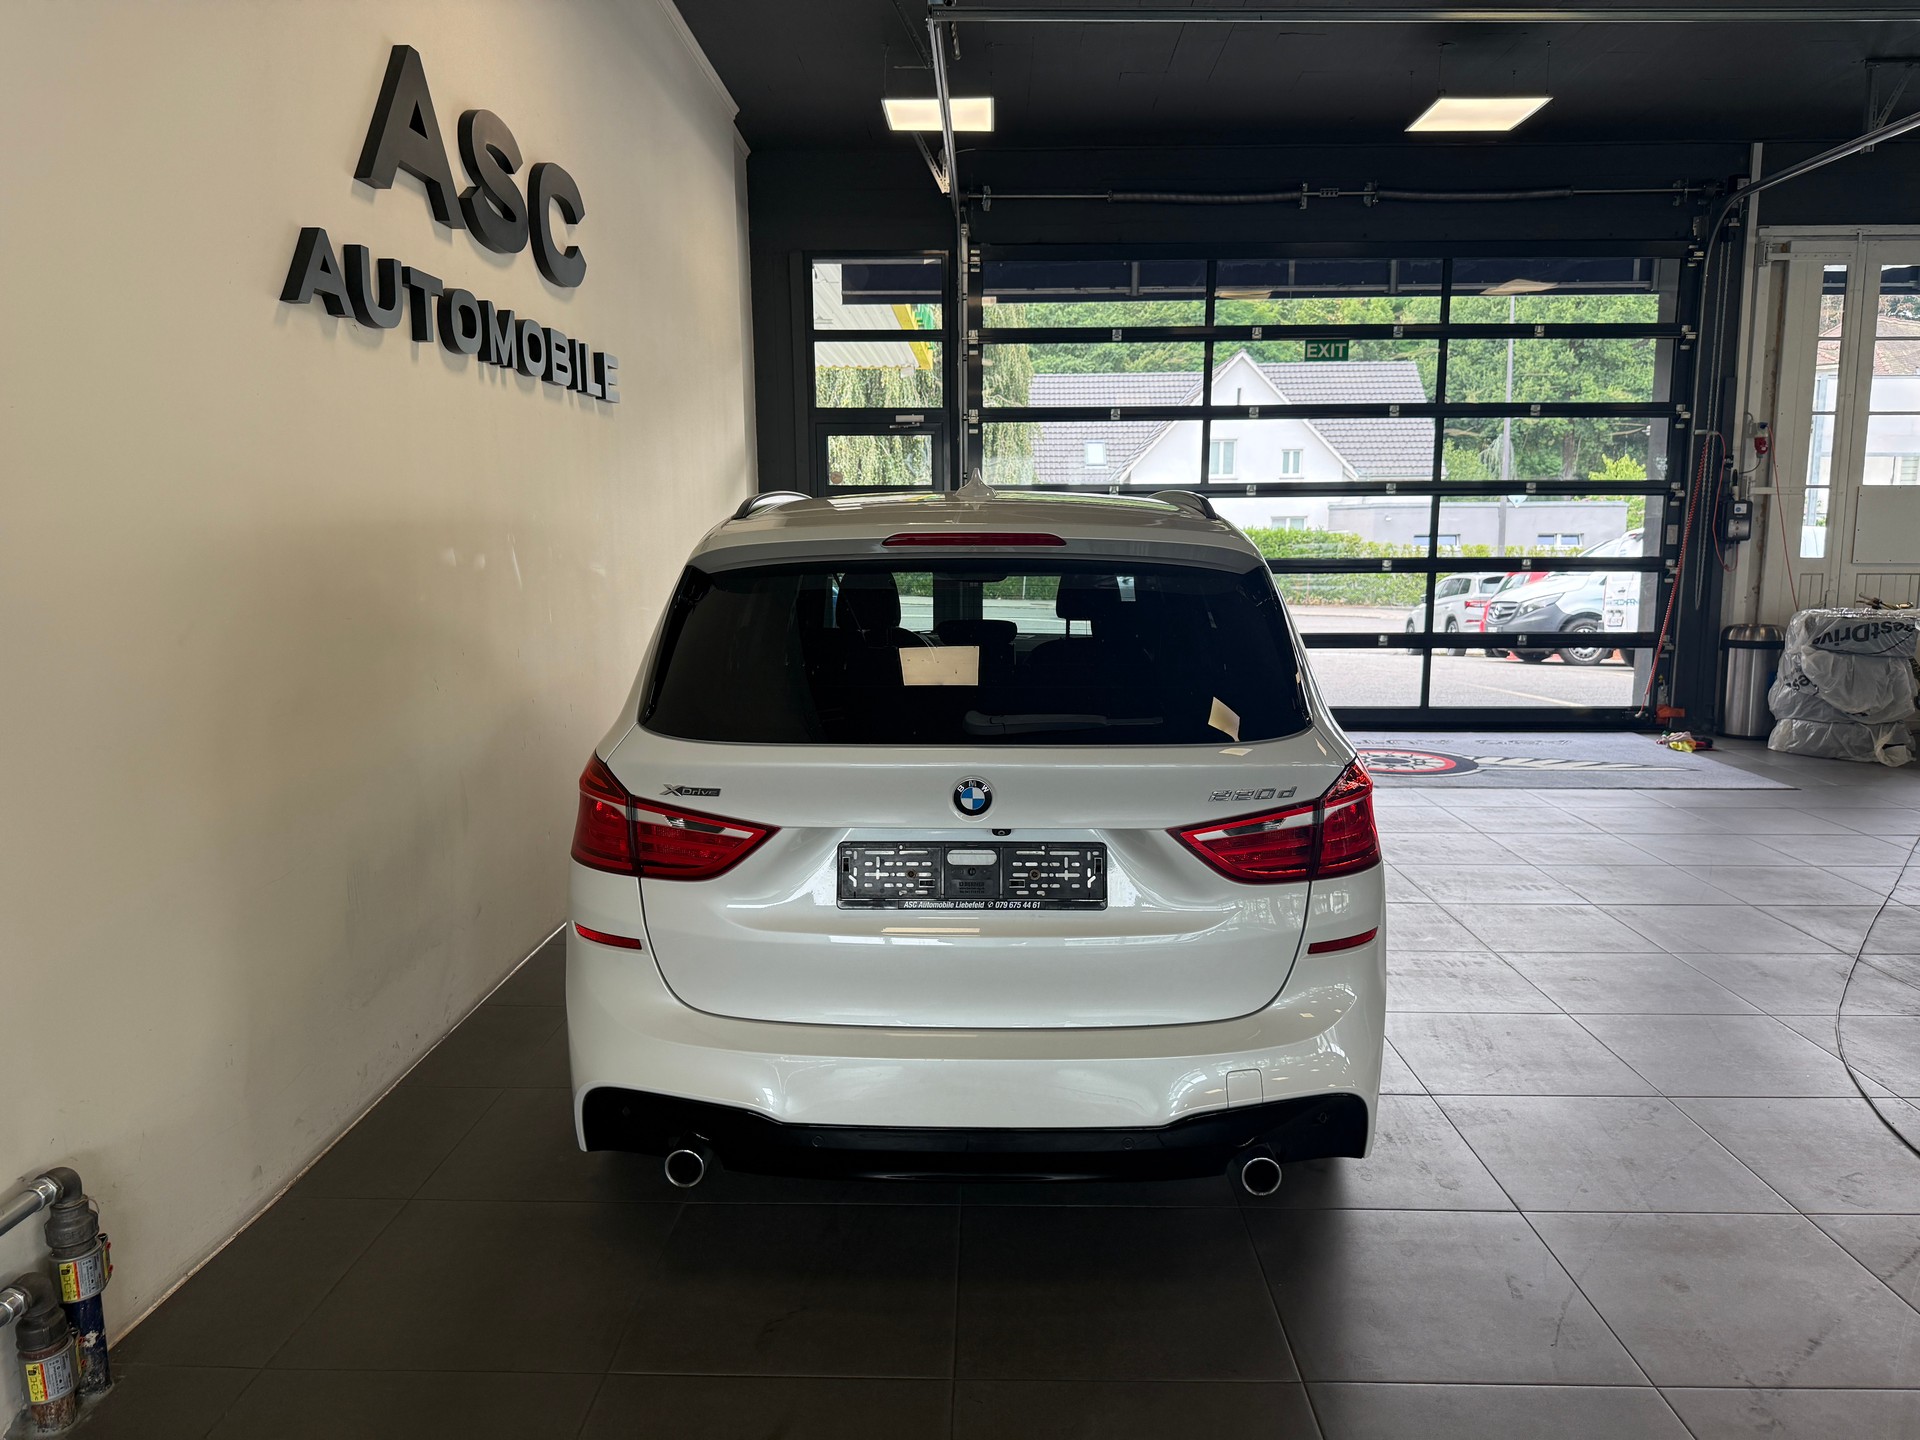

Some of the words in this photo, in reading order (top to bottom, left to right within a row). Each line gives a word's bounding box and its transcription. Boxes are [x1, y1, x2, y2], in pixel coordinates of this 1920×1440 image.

[354, 44, 588, 288] ASC
[279, 227, 620, 404] AUTOMOBILE
[1306, 343, 1347, 358] EXIT
[957, 780, 989, 793] BMW
[1208, 785, 1298, 802] 220d
[903, 901, 917, 909] ASC
[955, 901, 985, 909] Liebefeld
[995, 901, 1008, 909] 079
[1008, 901, 1022, 909] 675
[1022, 901, 1032, 909] 44
[1032, 901, 1041, 909] 61
